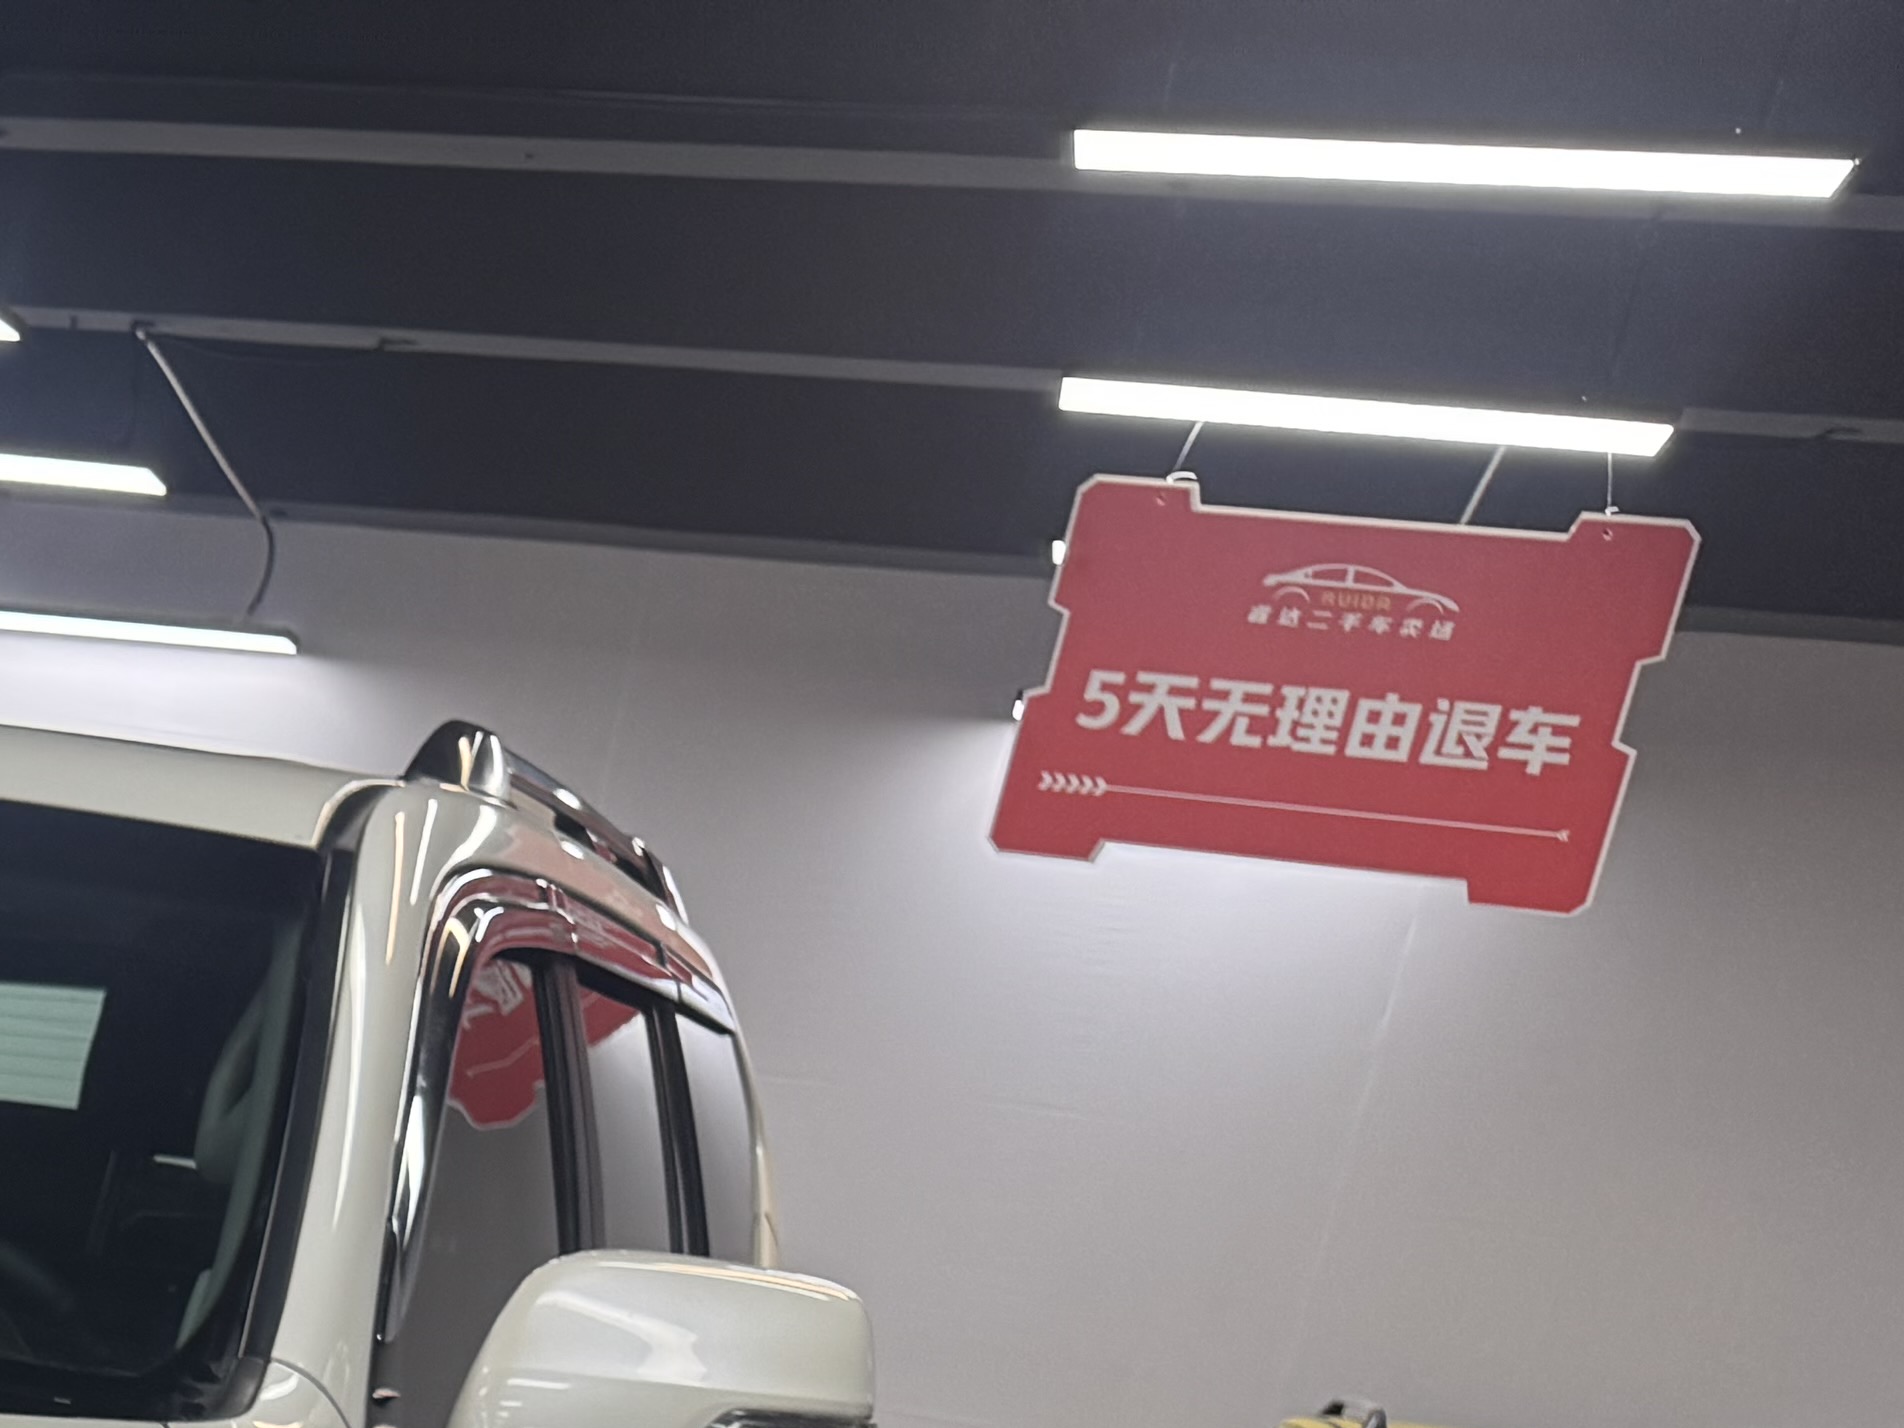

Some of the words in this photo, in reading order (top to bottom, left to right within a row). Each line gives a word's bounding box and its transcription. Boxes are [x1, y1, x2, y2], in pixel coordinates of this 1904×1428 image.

[1076, 668, 1581, 776] 5天无理由退车
